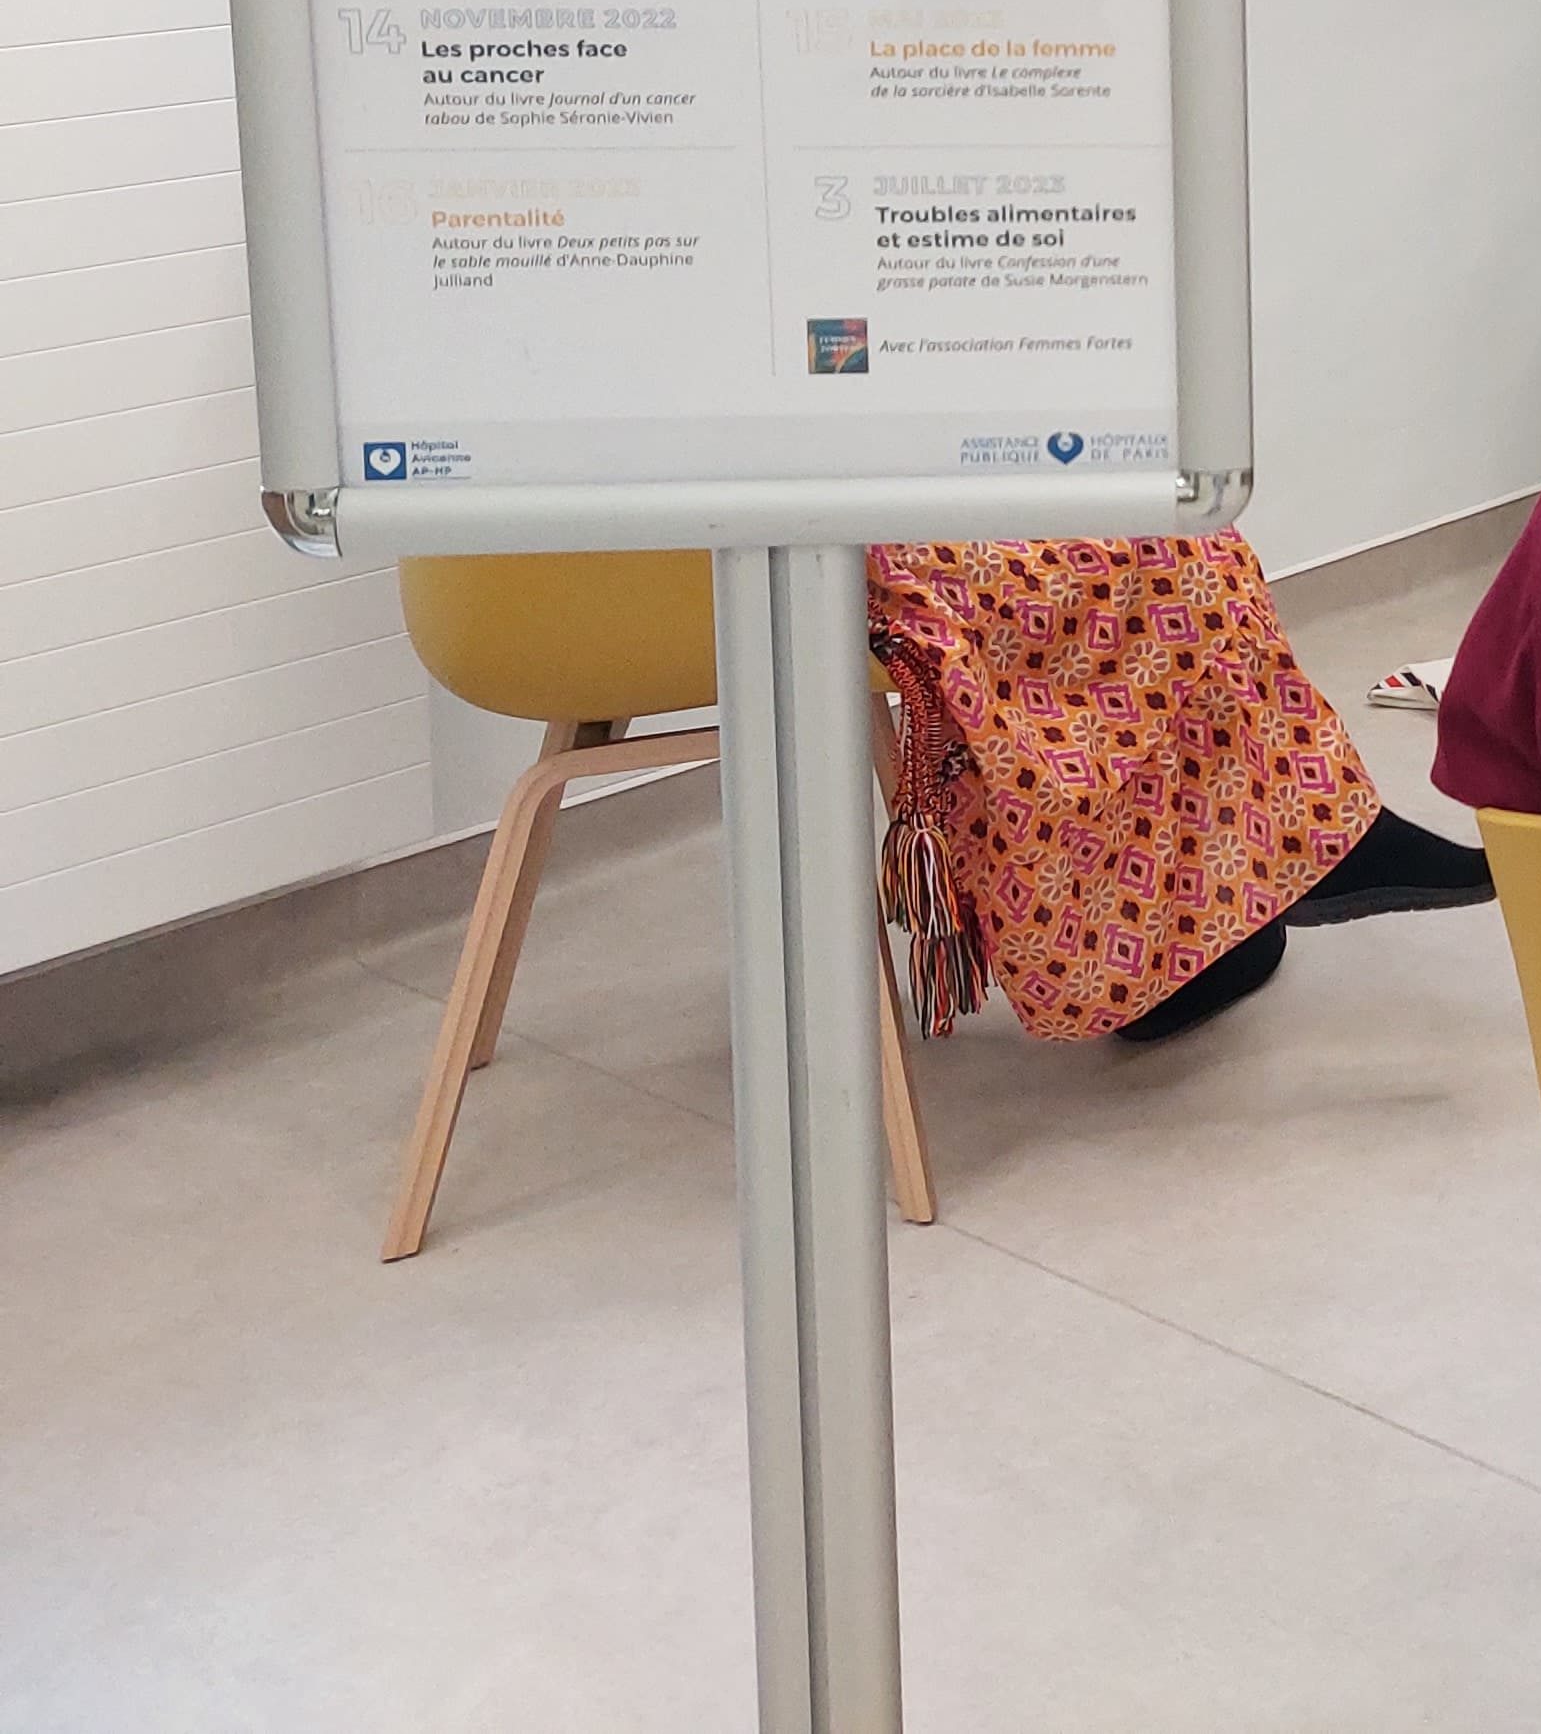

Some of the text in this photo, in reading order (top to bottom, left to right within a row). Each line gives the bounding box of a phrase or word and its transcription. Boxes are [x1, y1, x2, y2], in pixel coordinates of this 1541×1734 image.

[420, 7, 678, 30] NOVEMBRE 2022
[338, 7, 408, 55] 14
[421, 39, 629, 62] Les proches face
[870, 39, 1117, 62] La place de la femme
[423, 68, 546, 84] au cancer
[870, 66, 1010, 80] Autour du livre Le
[423, 91, 697, 109] Autour du livre Journal d'un cancer
[871, 84, 889, 98] de
[893, 84, 908, 98] la
[475, 111, 495, 126] de
[500, 111, 556, 128] Sophie
[872, 174, 989, 197] JUILLET
[814, 175, 852, 220] 3
[431, 208, 566, 229] Parentalité
[875, 202, 1137, 225] Troubles alimentaires
[432, 235, 701, 251] Autour du livre Deux petits pas sur
[876, 229, 1065, 249] et estime de soi
[432, 254, 447, 269] le
[451, 254, 492, 269] sable
[556, 253, 695, 271] d'Anne-Dauphine
[878, 339, 915, 354] Avec
[919, 337, 1012, 354] l'association
[1018, 337, 1082, 352] Femmes
